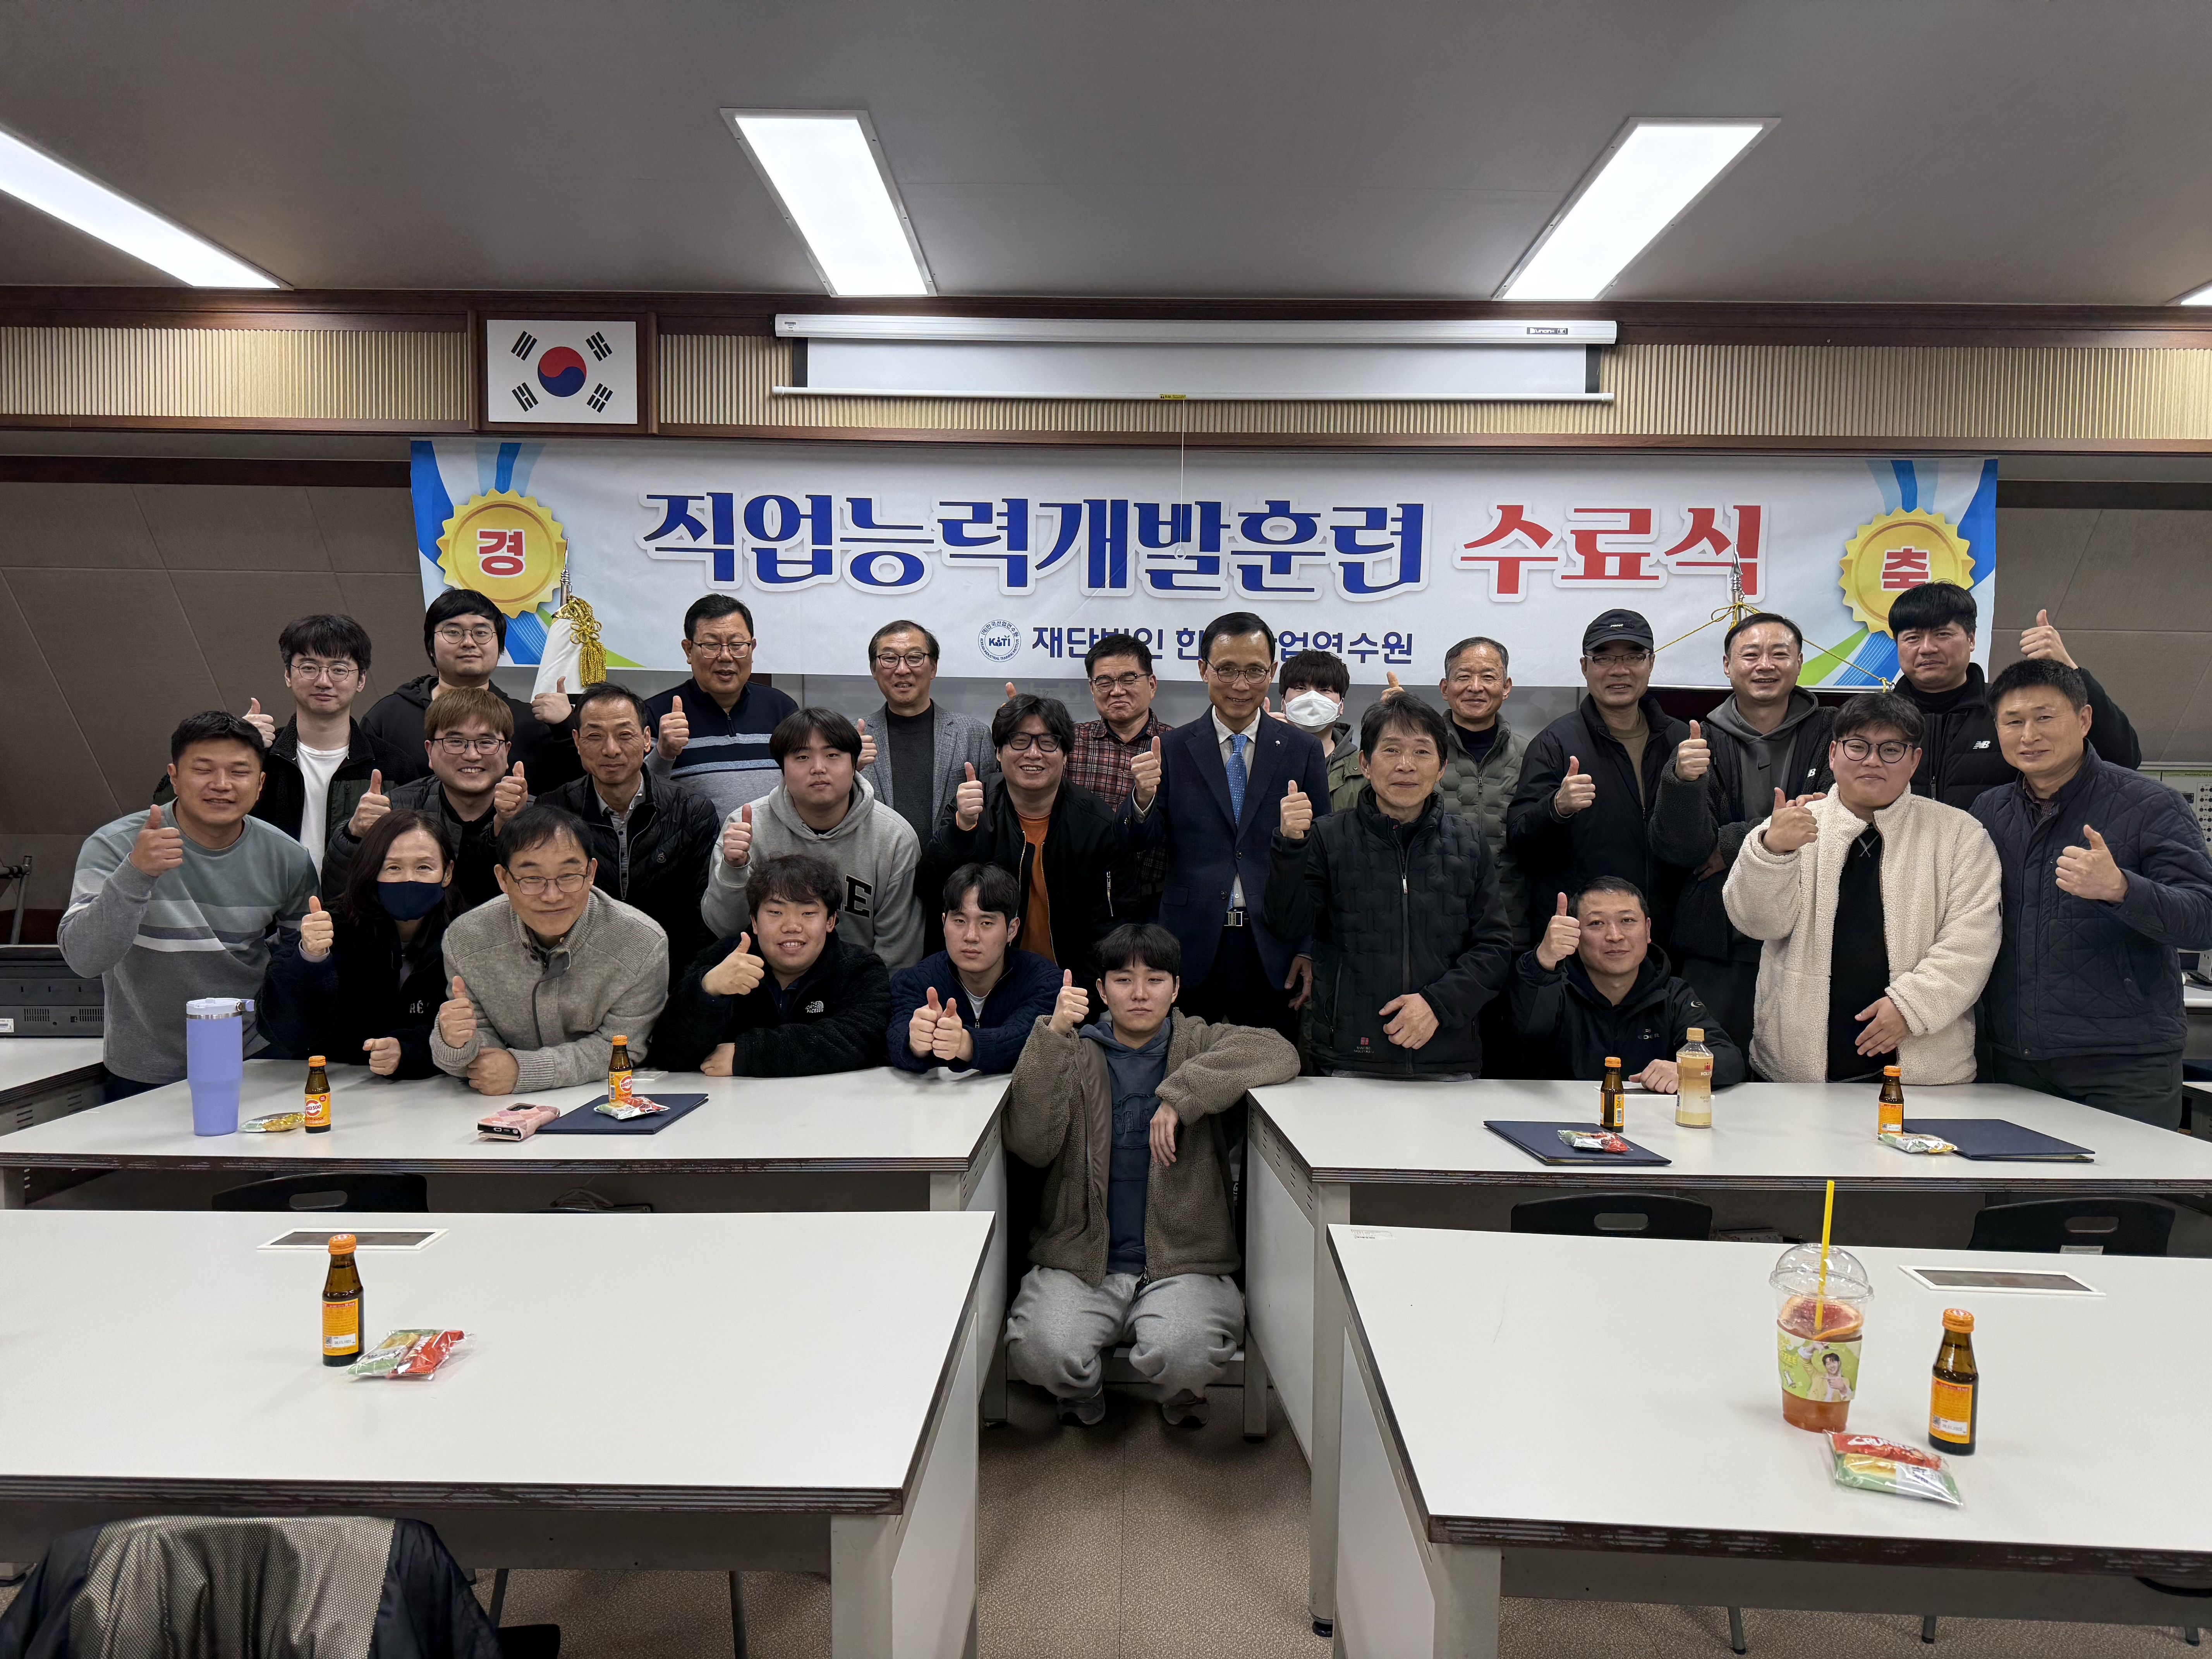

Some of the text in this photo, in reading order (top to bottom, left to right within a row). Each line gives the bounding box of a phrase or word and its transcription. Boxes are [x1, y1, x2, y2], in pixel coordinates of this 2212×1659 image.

[479, 531, 524, 576] 경
[643, 492, 1761, 595] 직업능력개발훈련 수료식
[1882, 548, 1929, 589] 축
